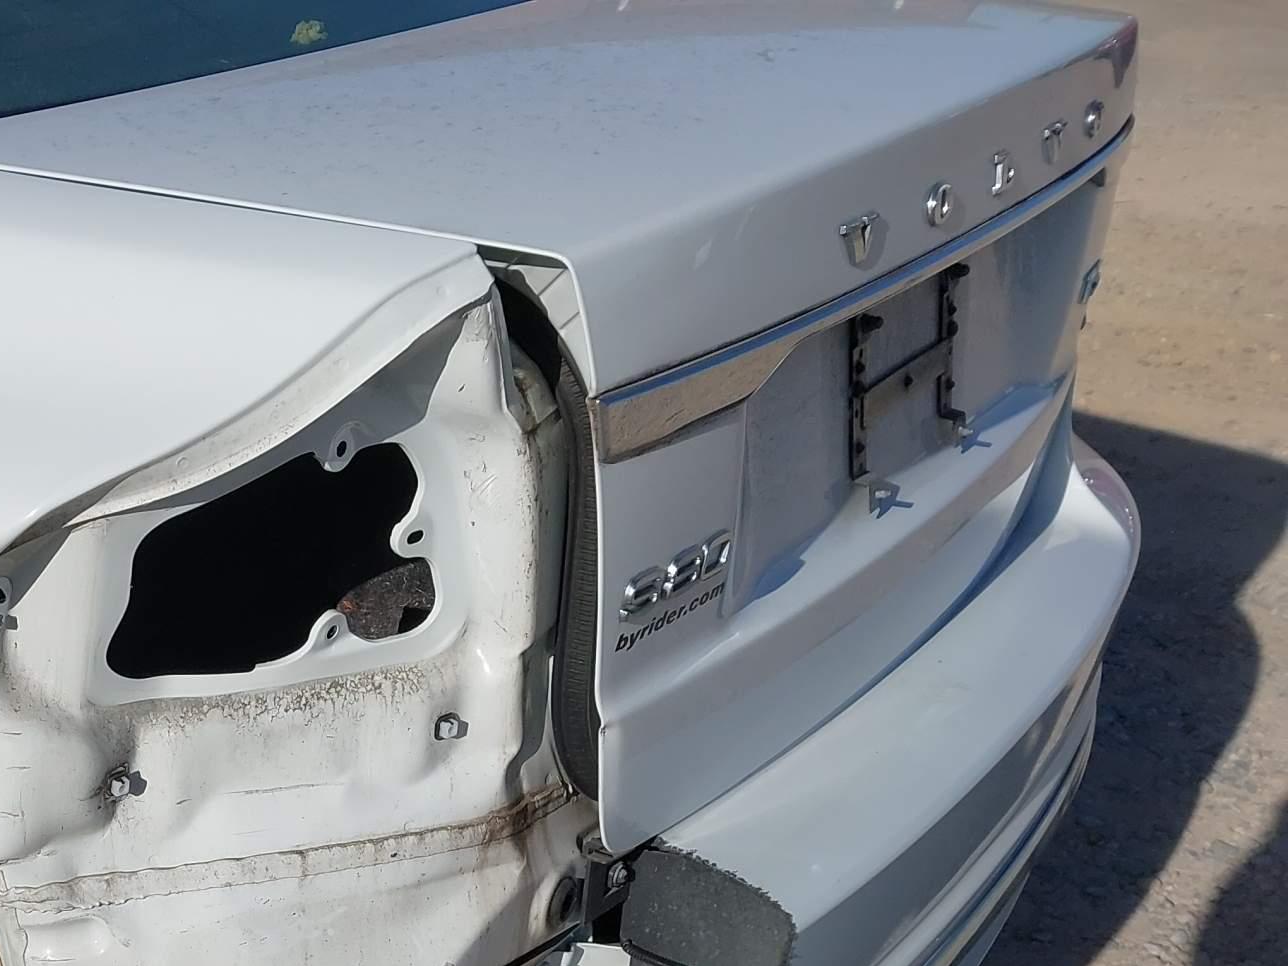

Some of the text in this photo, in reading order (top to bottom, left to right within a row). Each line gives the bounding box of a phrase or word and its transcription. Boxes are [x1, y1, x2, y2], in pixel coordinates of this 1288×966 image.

[839, 99, 1105, 265] VOLVO
[614, 581, 725, 653] byrider.com
[618, 528, 732, 623] S80
